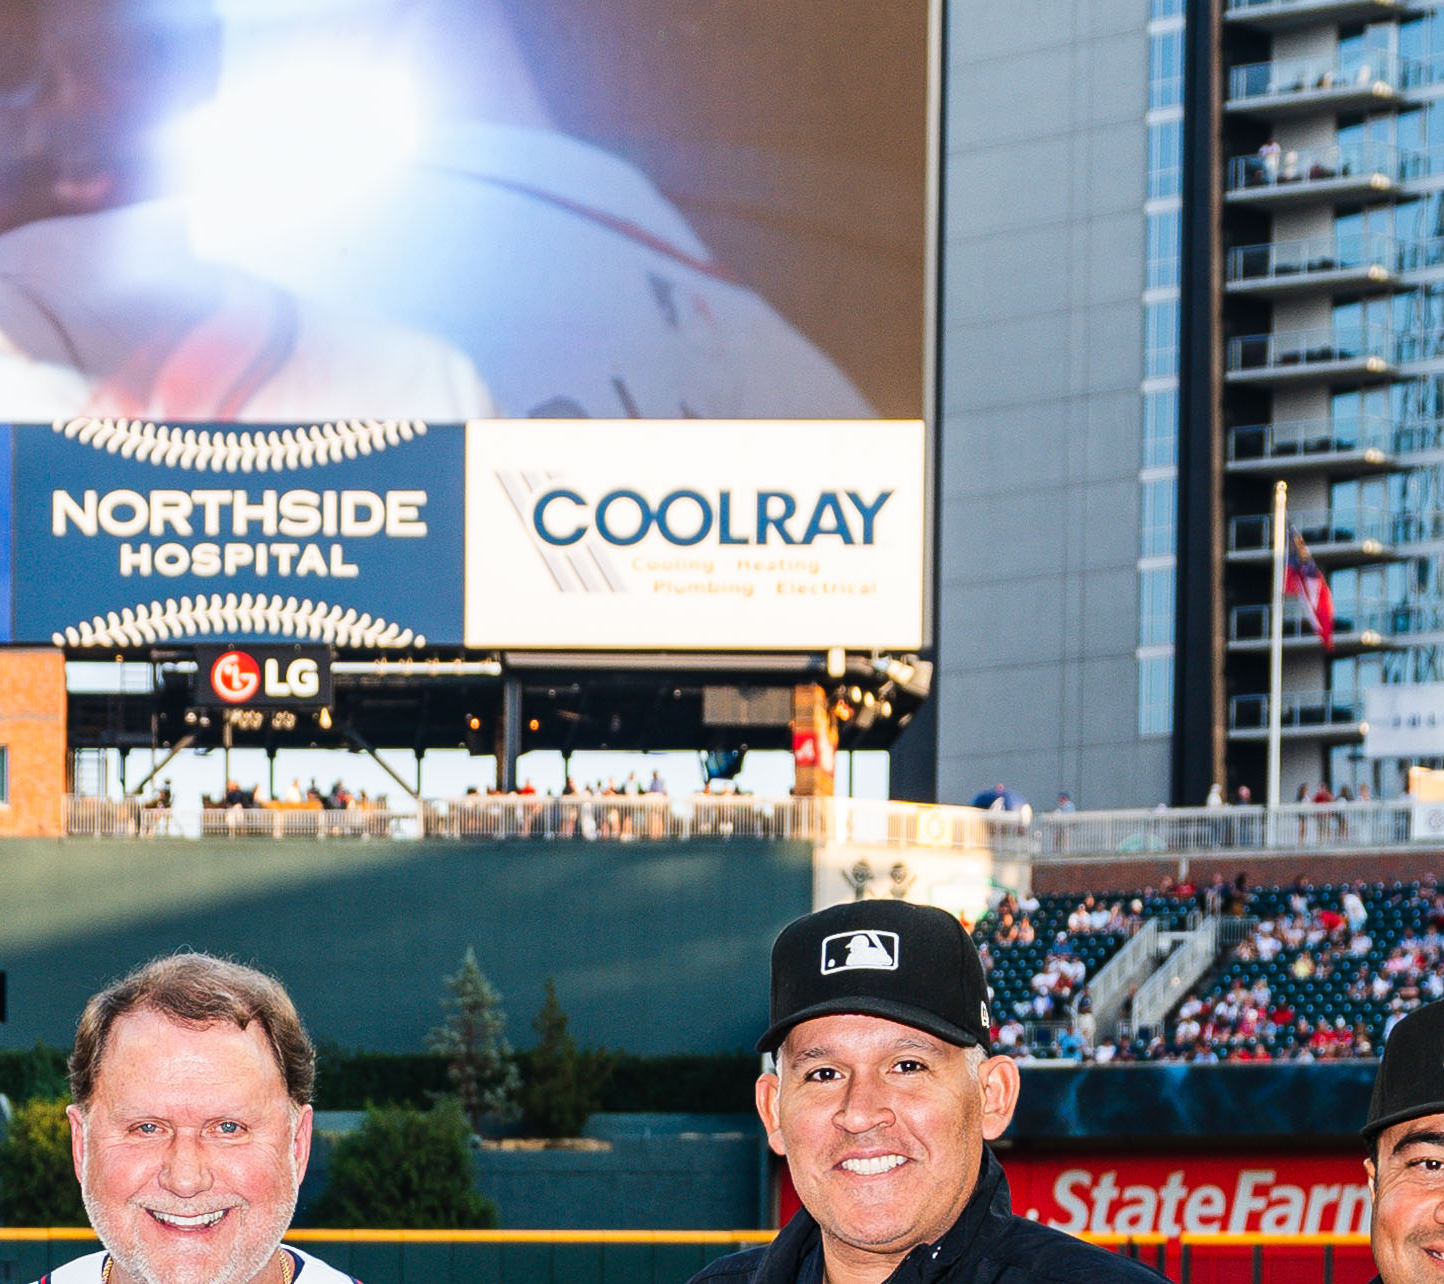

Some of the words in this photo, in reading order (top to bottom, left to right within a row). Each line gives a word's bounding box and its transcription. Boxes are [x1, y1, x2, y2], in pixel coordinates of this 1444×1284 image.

[51, 489, 429, 537] NORTHSIDE
[532, 488, 896, 547] COOLRAY
[118, 543, 360, 578] HOSPITAL
[630, 557, 715, 574] Cooling
[737, 557, 820, 575] Heating
[653, 579, 755, 597] Plumbing
[775, 579, 878, 594] Electrical
[264, 659, 319, 697] LG
